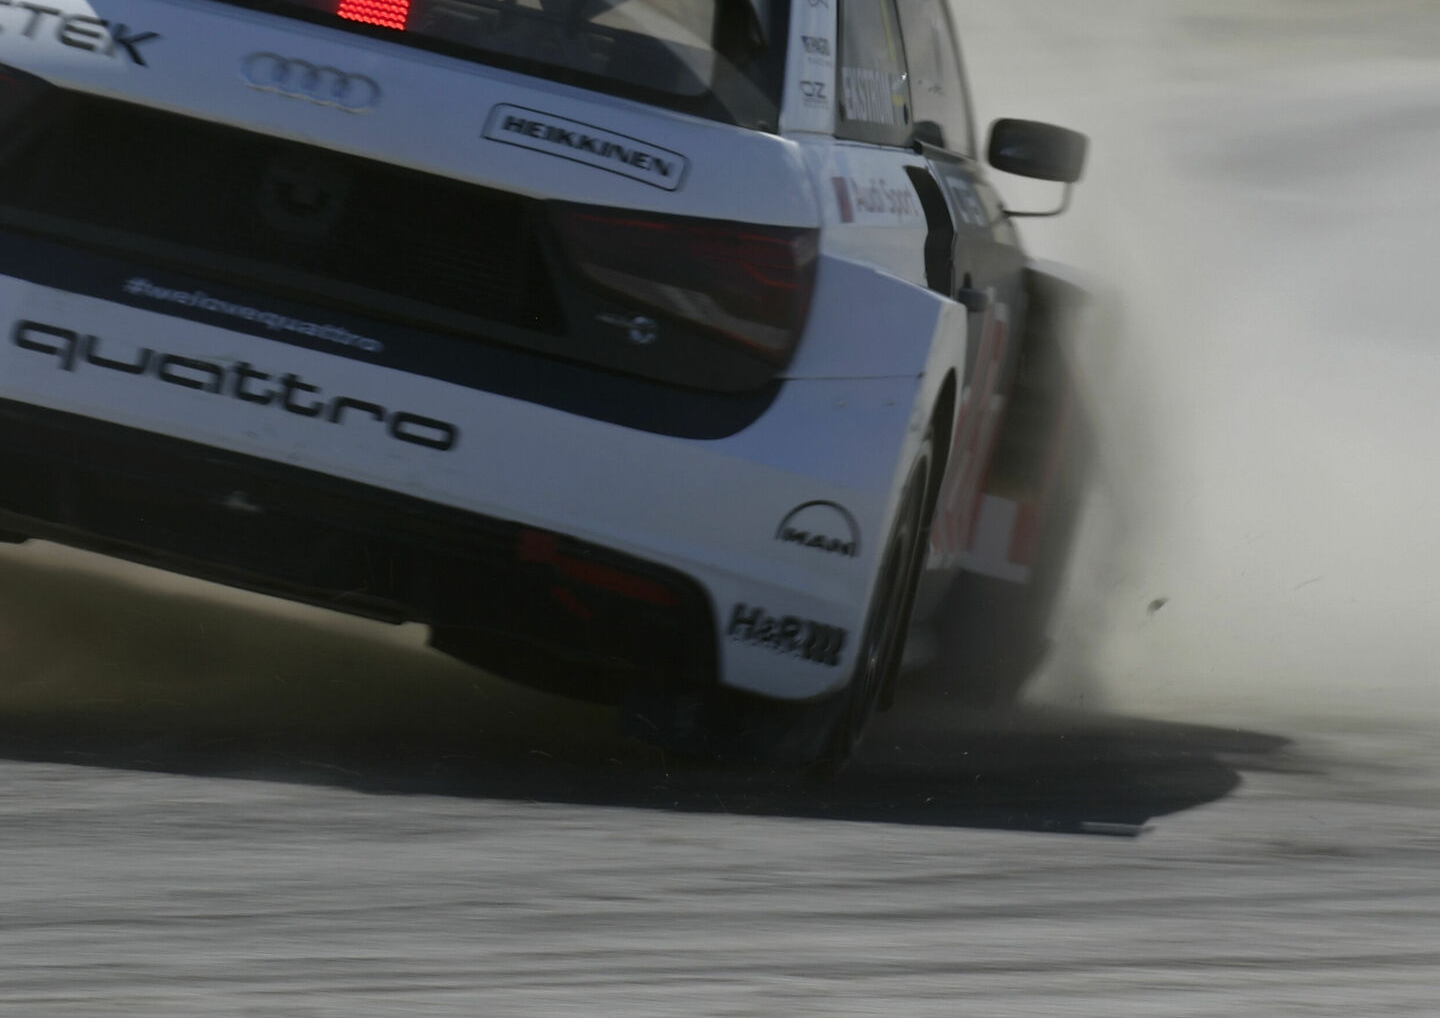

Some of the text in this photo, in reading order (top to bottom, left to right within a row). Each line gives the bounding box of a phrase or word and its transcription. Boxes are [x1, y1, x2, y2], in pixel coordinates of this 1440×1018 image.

[501, 114, 673, 177] HEIKKINEN
[12, 319, 459, 451] quattro
[781, 528, 857, 557] MAN
